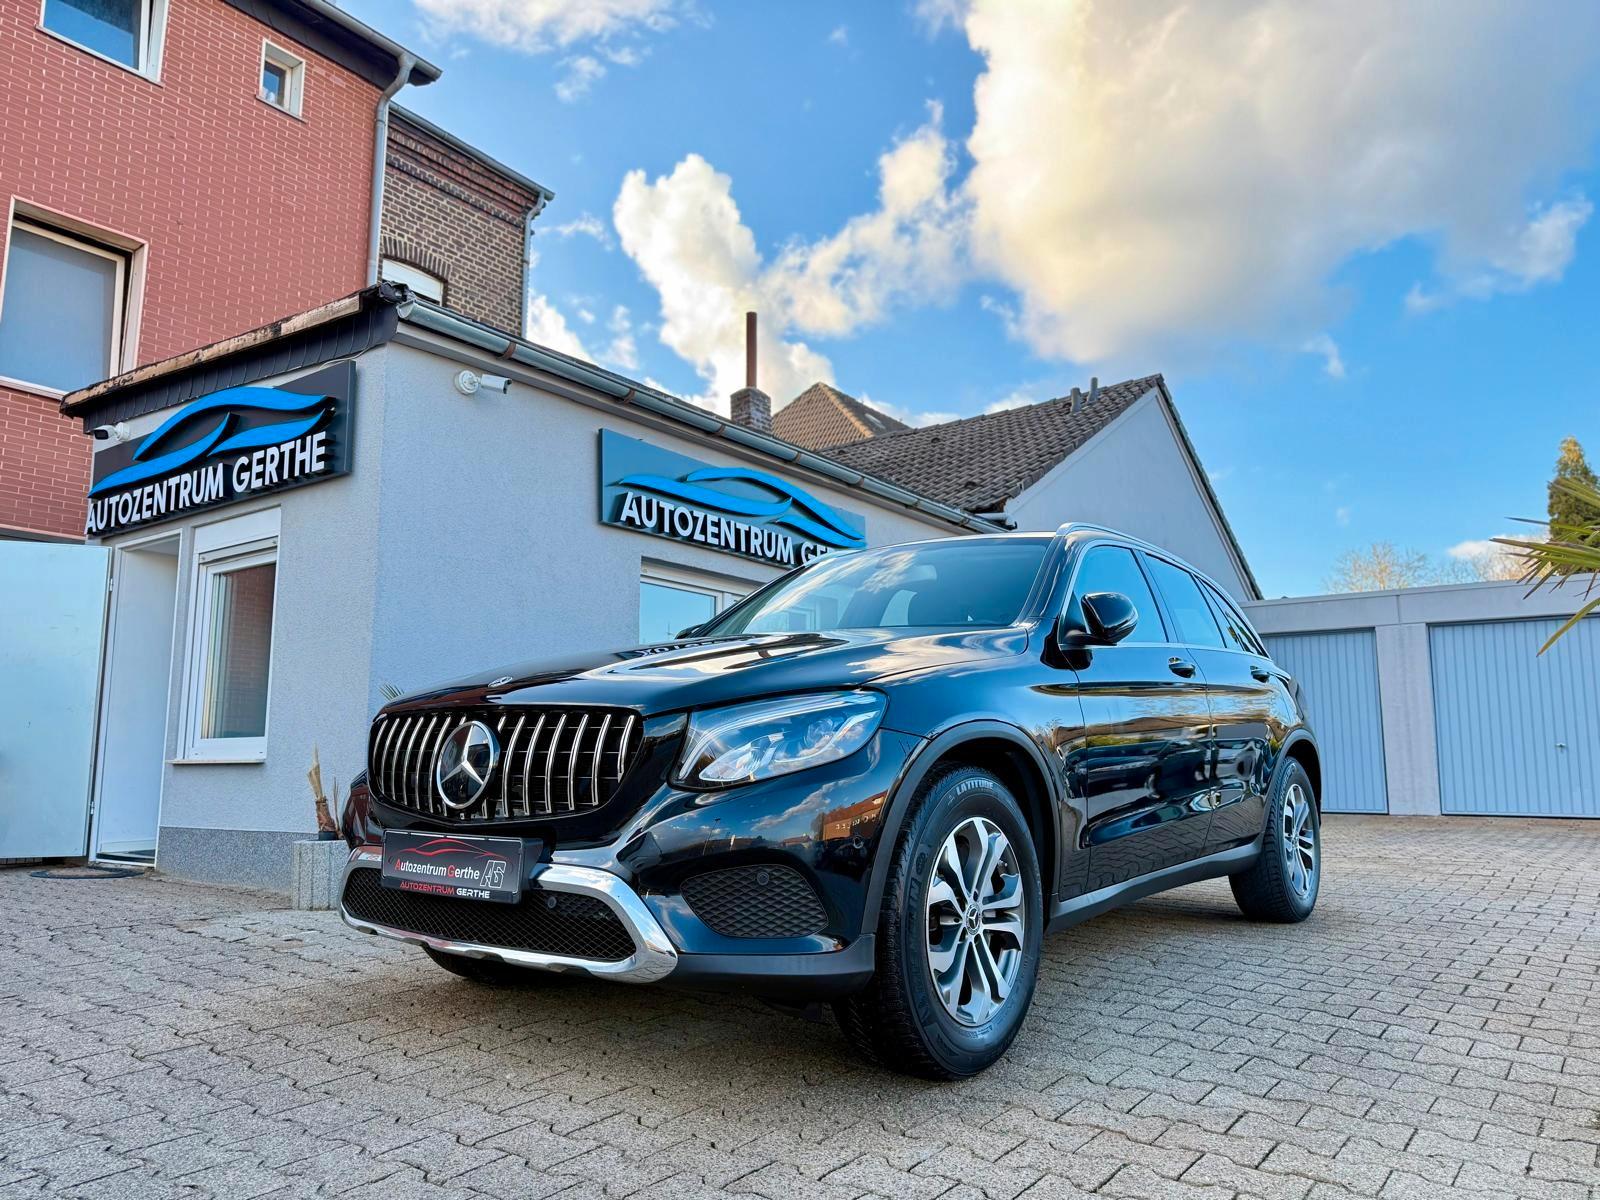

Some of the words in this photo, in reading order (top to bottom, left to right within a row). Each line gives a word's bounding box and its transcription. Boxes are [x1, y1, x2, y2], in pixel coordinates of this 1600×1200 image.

[84, 462, 225, 535] AUTOZENTRUM
[232, 430, 327, 493] GERTHE
[620, 491, 795, 565] AUTOZENTRUM
[956, 779, 994, 795] LATITUDE
[394, 858, 447, 877] Autozentrum
[447, 865, 480, 880] Gerthe
[400, 881, 455, 895] AUTOZENTRUM
[456, 887, 490, 899] GERTHE
